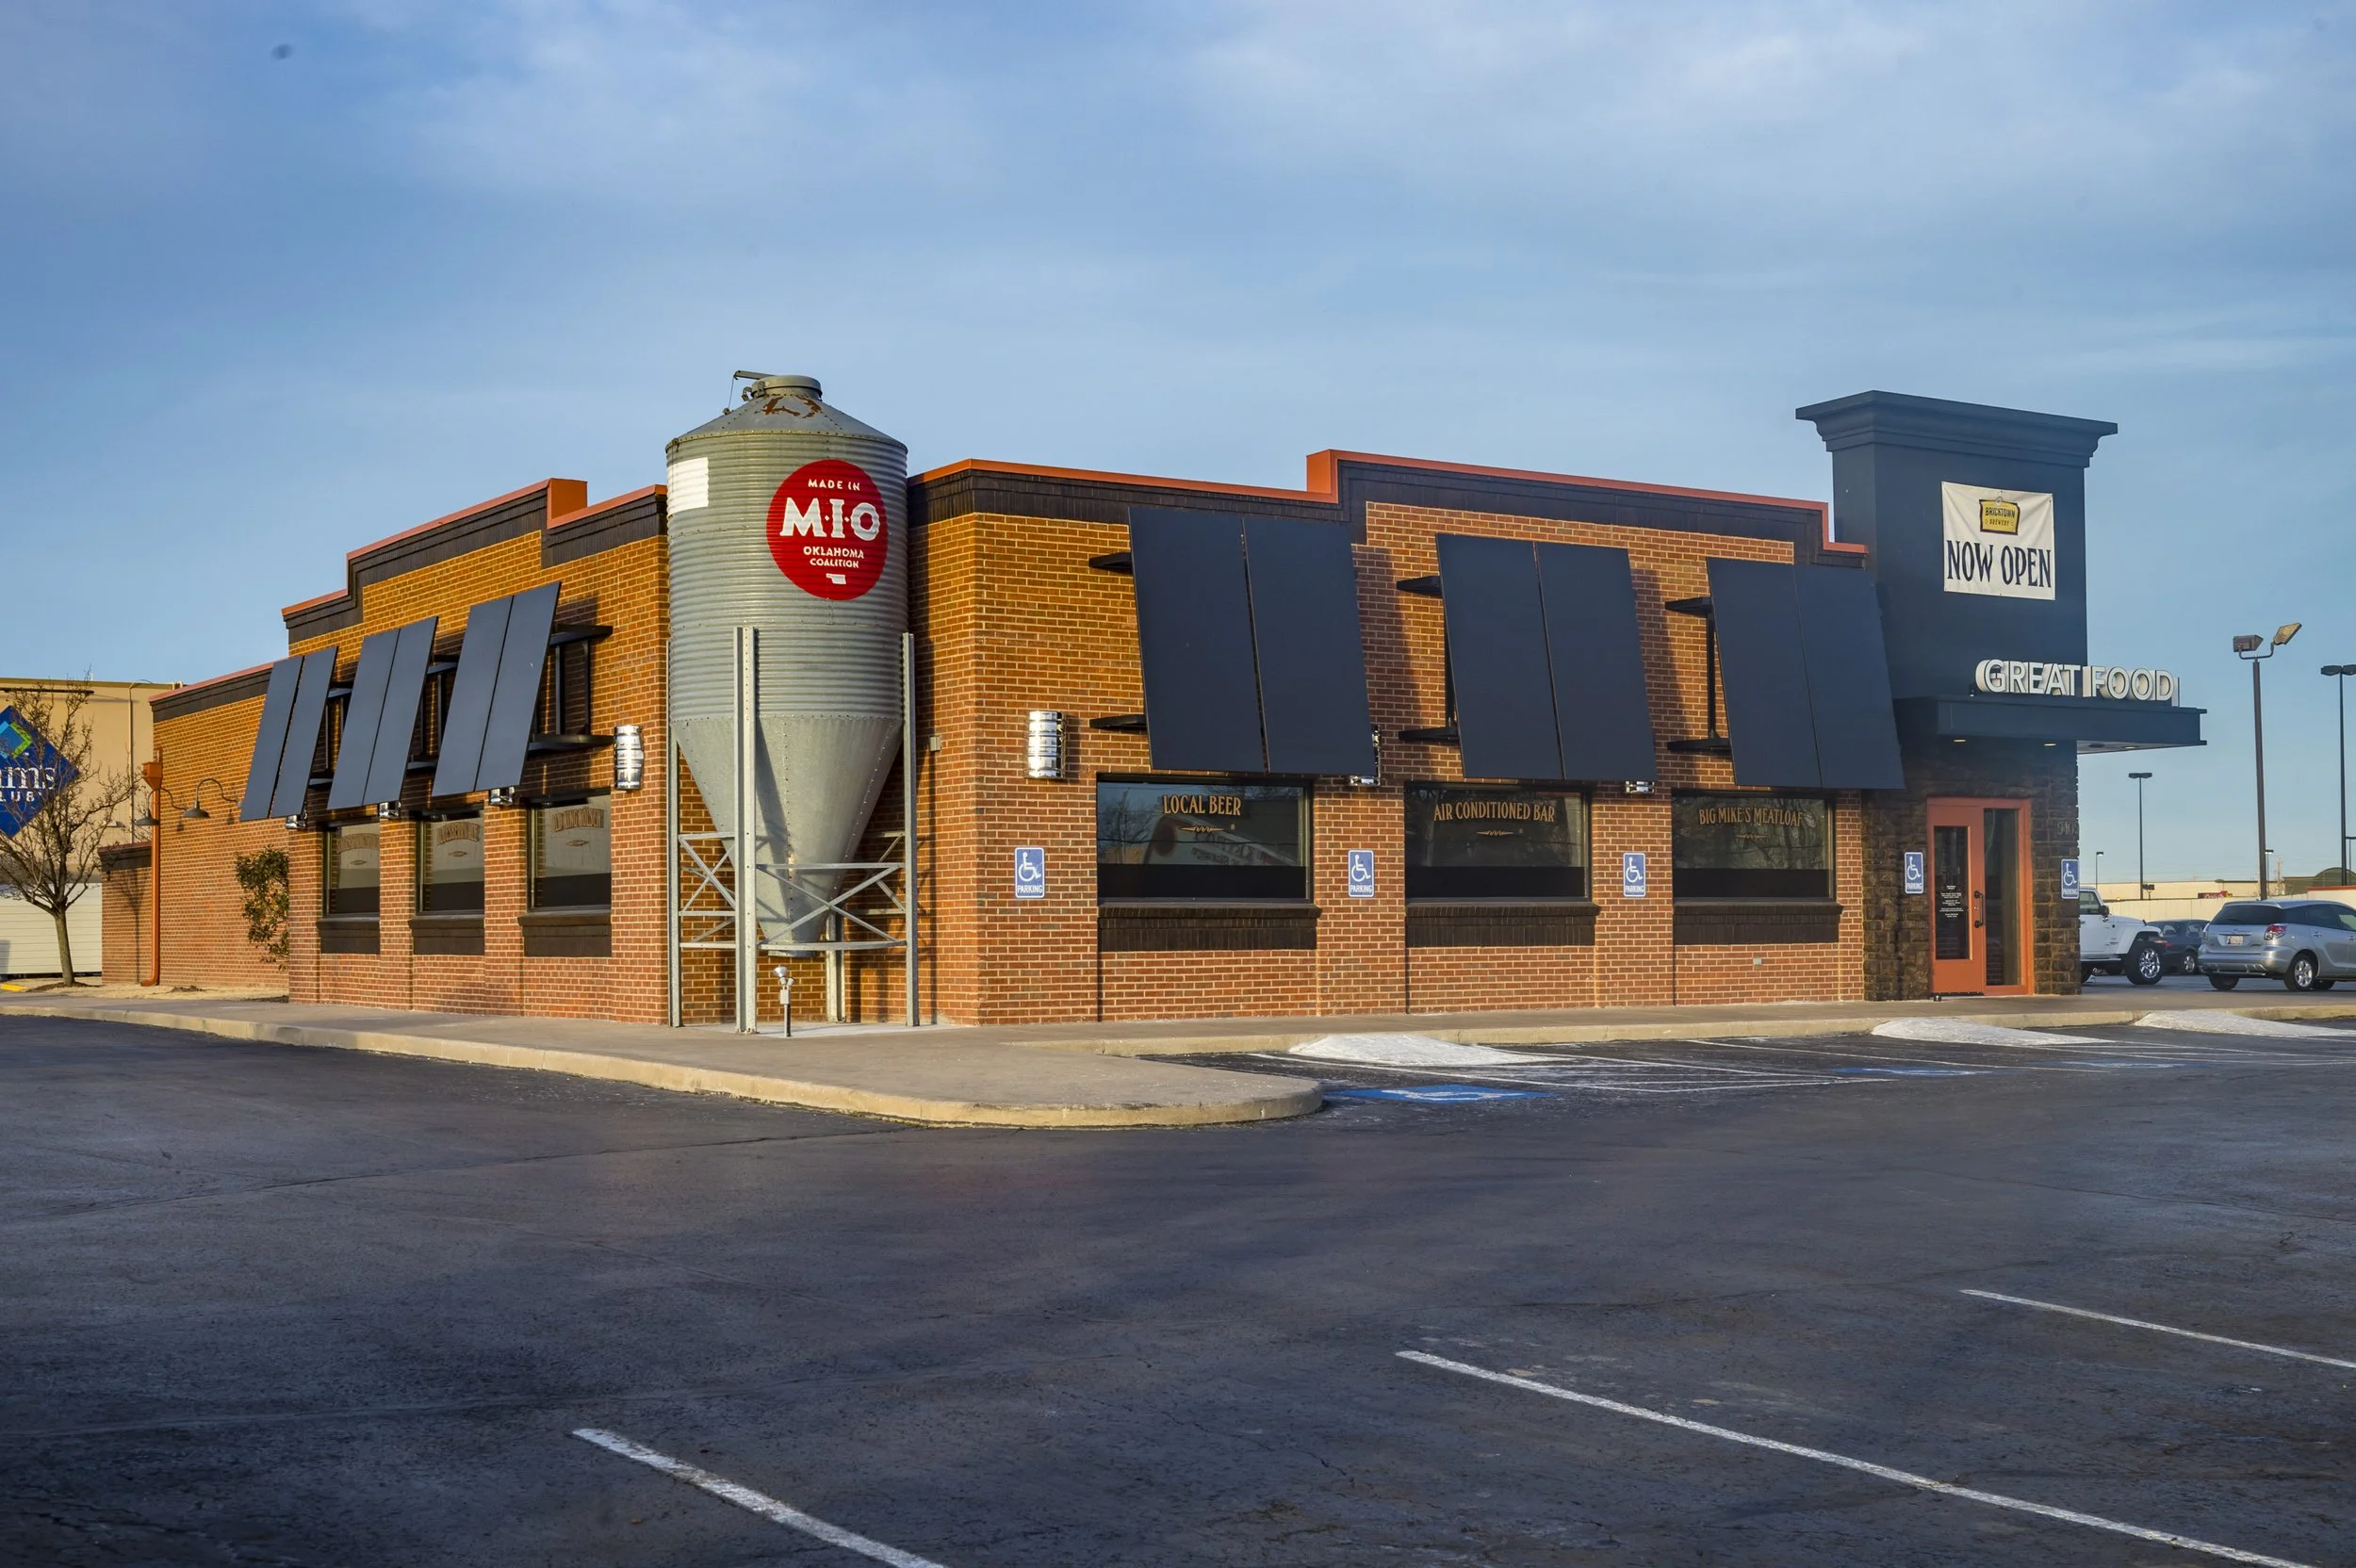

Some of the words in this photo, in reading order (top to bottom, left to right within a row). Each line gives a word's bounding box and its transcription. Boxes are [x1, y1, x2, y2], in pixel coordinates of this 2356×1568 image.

[808, 479, 843, 489] MADE
[848, 482, 860, 491] IN
[1985, 507, 2016, 518] BRICKTOWN
[1989, 518, 2009, 527] BREWERY
[803, 546, 864, 559] OKLAHOMA
[810, 558, 859, 568] COALITION
[1946, 540, 1993, 582] NOW
[2001, 545, 2052, 588] OPEN
[1976, 659, 2081, 696] GREAT
[2083, 665, 2174, 701] FOOD
[1162, 794, 1205, 815] LOCAL
[1209, 795, 1241, 816] BEER
[1433, 803, 1453, 822] AIR
[1455, 801, 1530, 820] CONDITIONED
[1533, 803, 1555, 823] BAR
[1698, 808, 1716, 825] BIG
[1718, 807, 1751, 824] MIKE'S
[1754, 807, 1803, 827] MEATLOAF
[1018, 885, 1042, 893] PARKING
[1350, 885, 1372, 893] PARKING
[1906, 882, 1923, 890] PARKING
